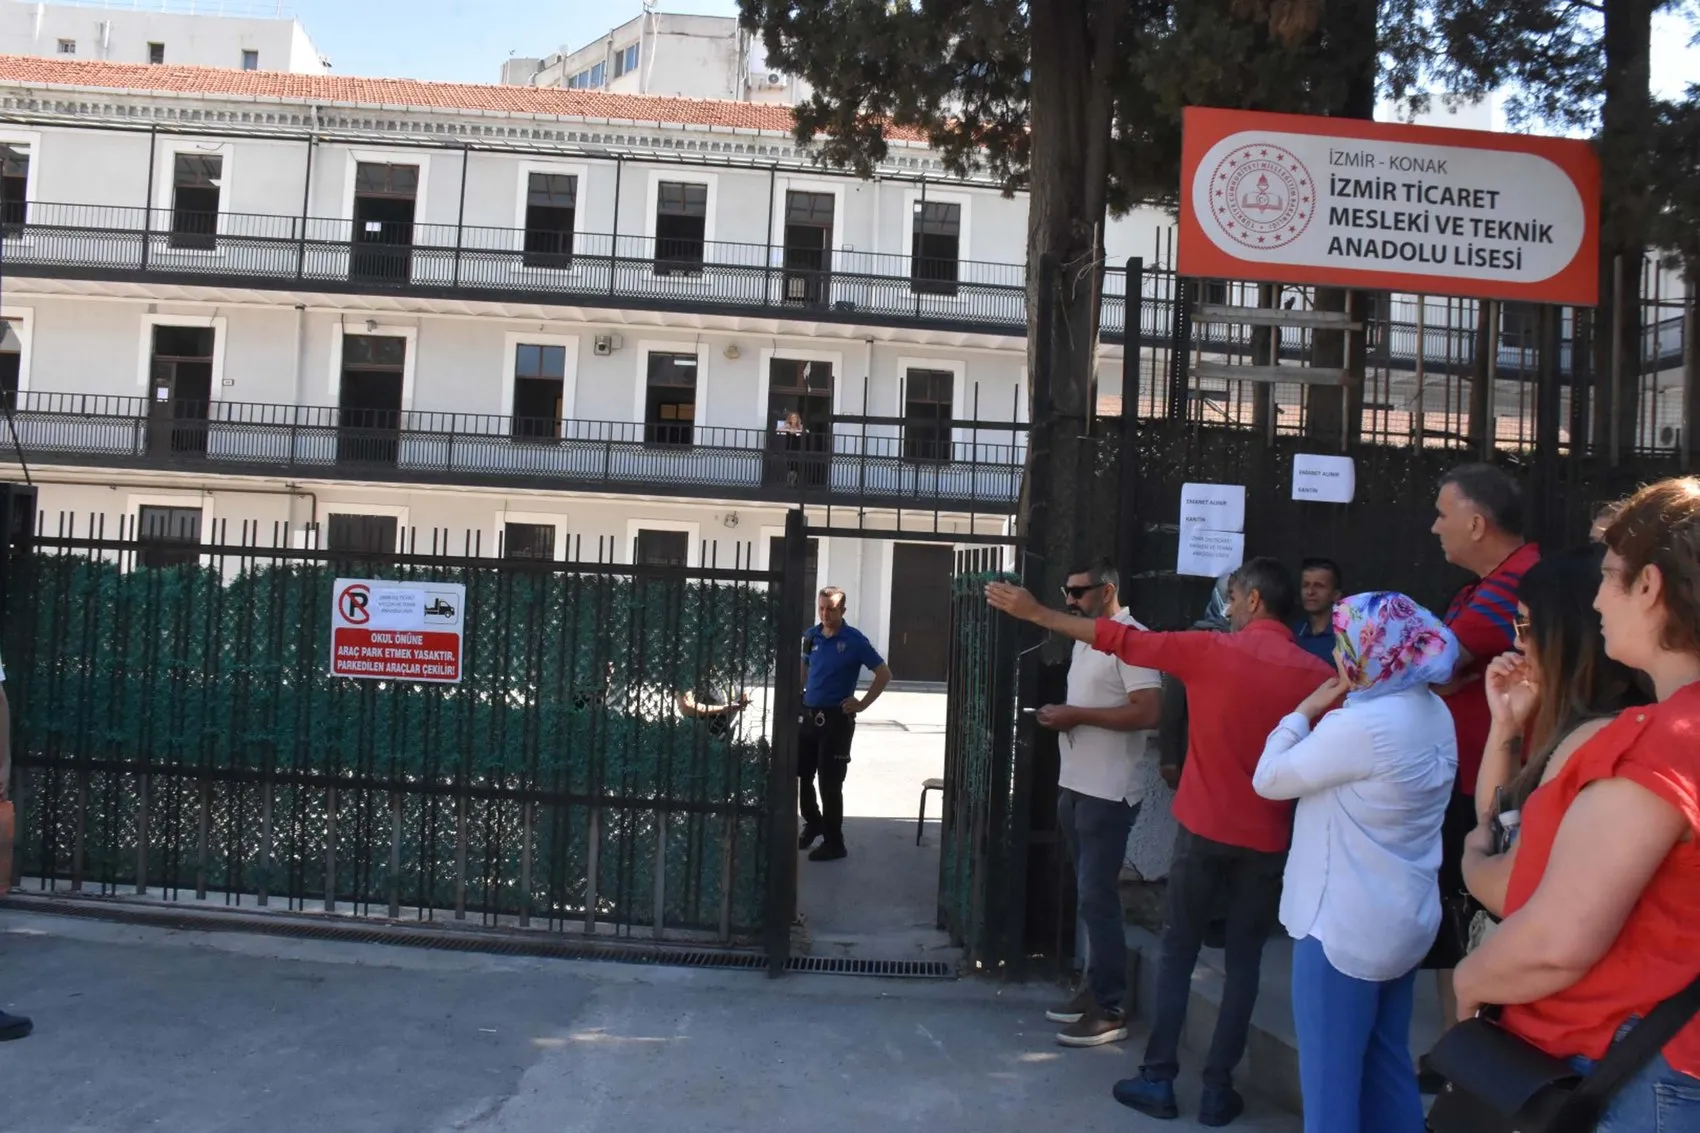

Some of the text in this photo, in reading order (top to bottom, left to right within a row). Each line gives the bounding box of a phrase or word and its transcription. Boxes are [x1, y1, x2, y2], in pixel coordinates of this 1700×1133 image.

[1329, 148, 1375, 168] İZMİR
[1389, 155, 1448, 174] KONAK
[1330, 173, 1500, 209] İZMİR TİCARET
[1329, 207, 1554, 244] MESLEKİ VE TEKNİK
[1328, 236, 1522, 270] ANADOLU LİSESİ
[371, 632, 423, 645] OKUL ÖNÜNE
[338, 646, 455, 661] ARAÇ PARK ETMEK YASAKTIR.
[337, 659, 455, 677] PARKEDİLEN ARAÇLAR ÇEKİLİR!
